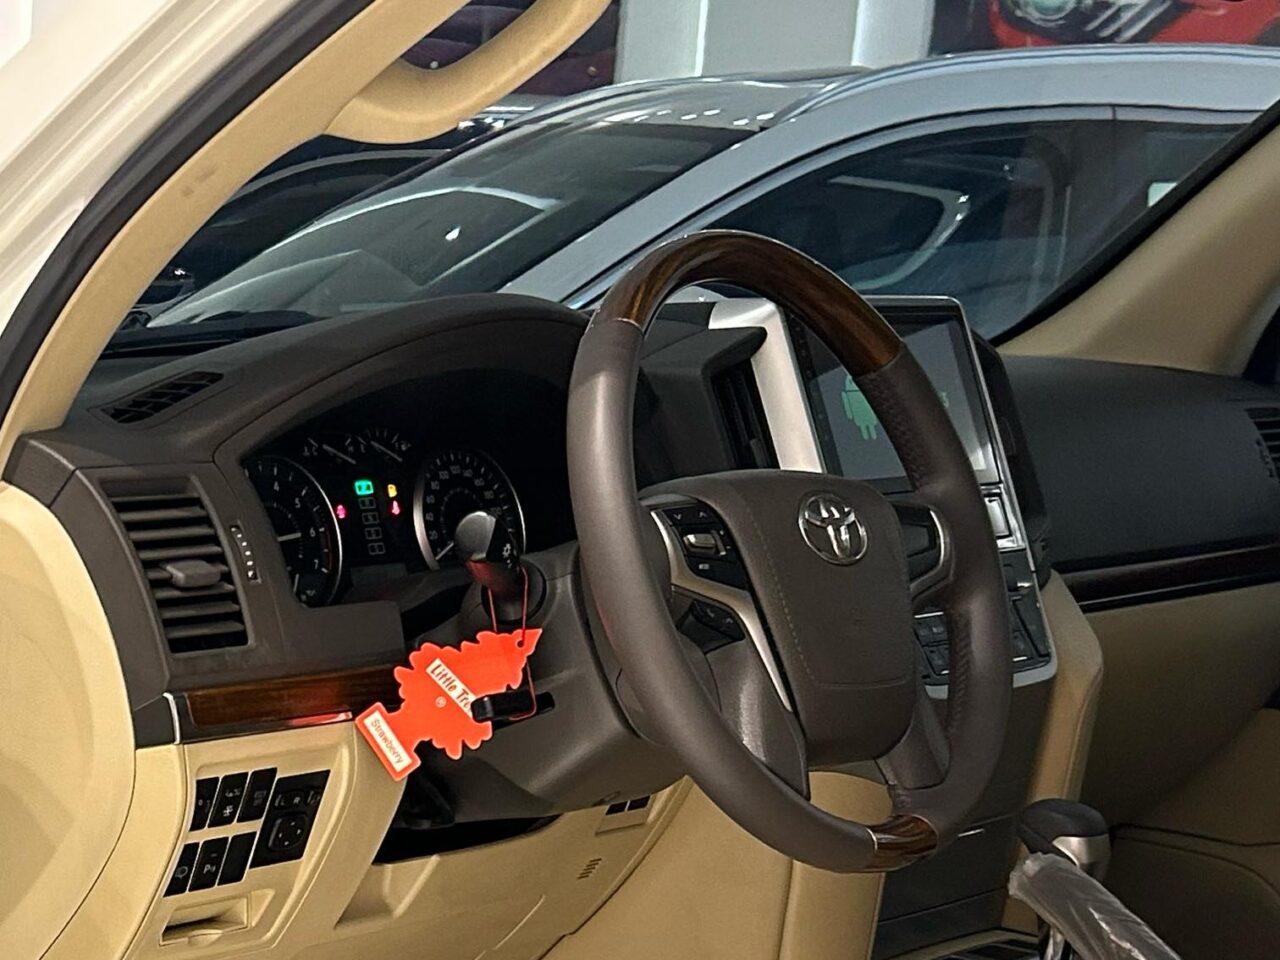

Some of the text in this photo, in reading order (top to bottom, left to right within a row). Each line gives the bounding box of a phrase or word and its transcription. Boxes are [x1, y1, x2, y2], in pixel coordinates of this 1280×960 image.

[430, 663, 472, 712] Little Tre
[371, 718, 403, 764] Strawberry
